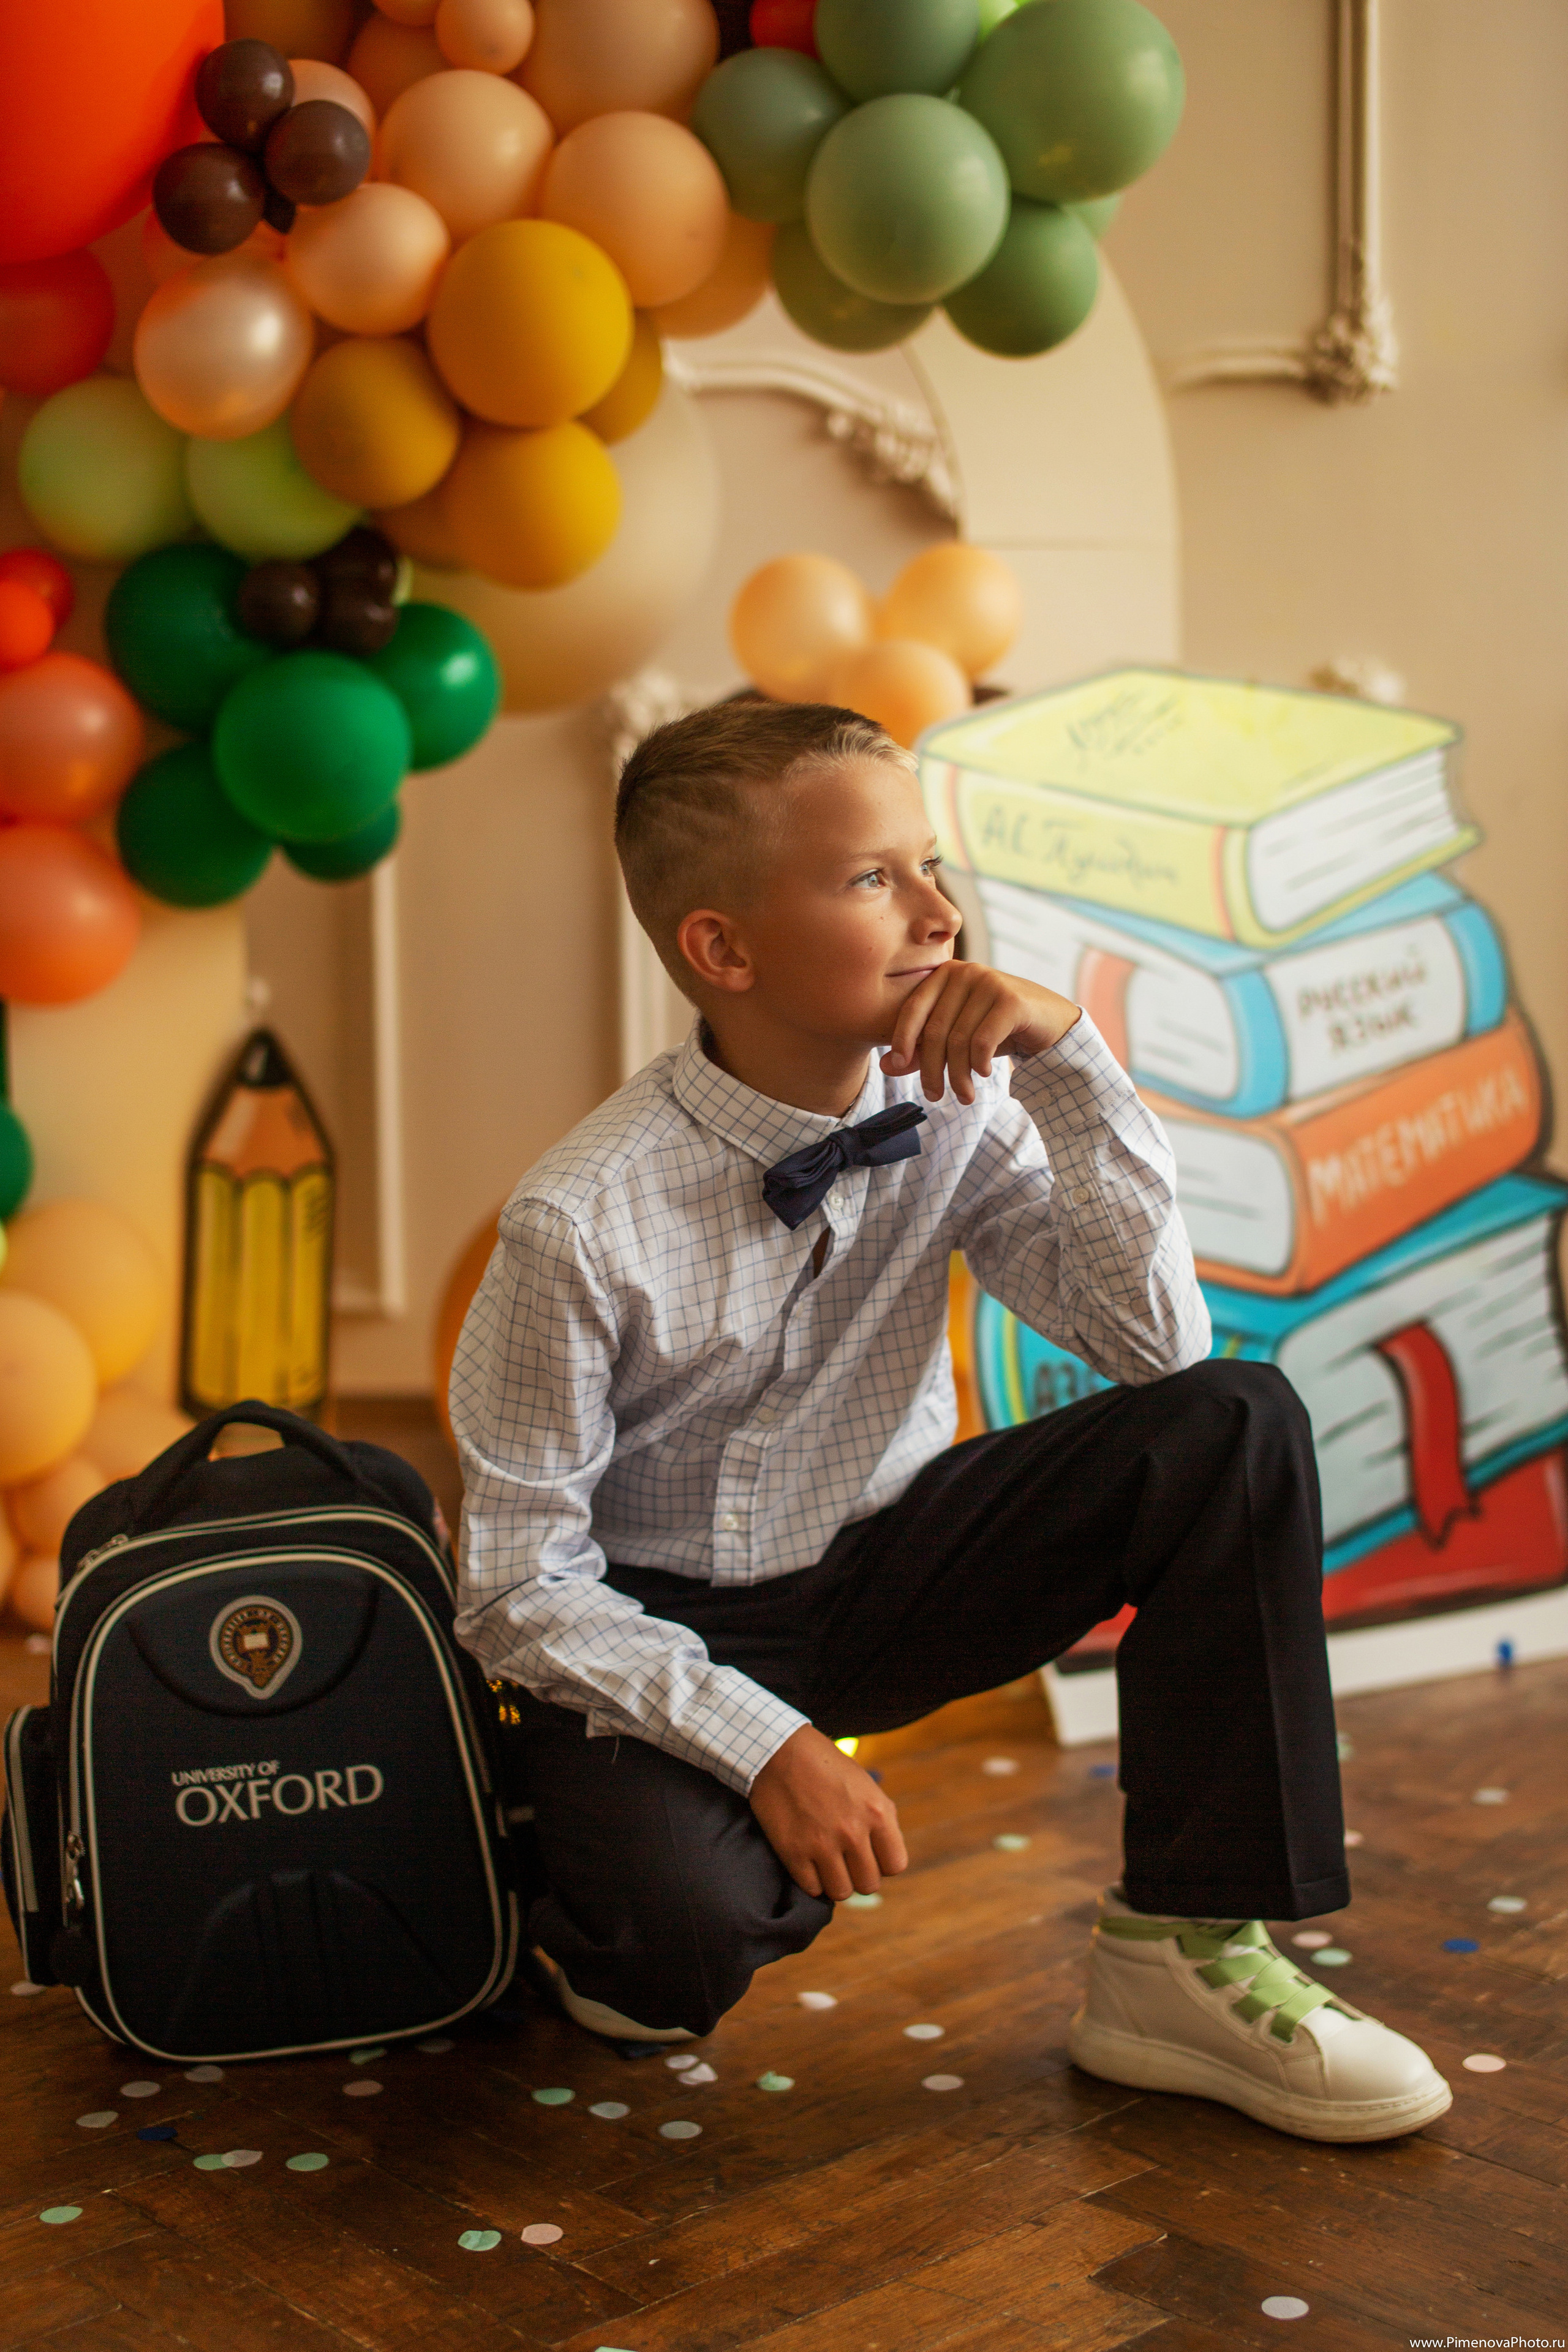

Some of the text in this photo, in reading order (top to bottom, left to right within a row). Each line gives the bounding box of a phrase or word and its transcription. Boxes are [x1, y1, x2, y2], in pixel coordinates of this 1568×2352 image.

[1297, 944, 1427, 1021] РУССКИЙ
[1328, 1005, 1416, 1057] ЯЗЫК
[1307, 1068, 1529, 1229] МАТЕМАТИКА
[172, 1760, 280, 1786] UNIVERSITY OF
[175, 1764, 384, 1826] OXFORD
